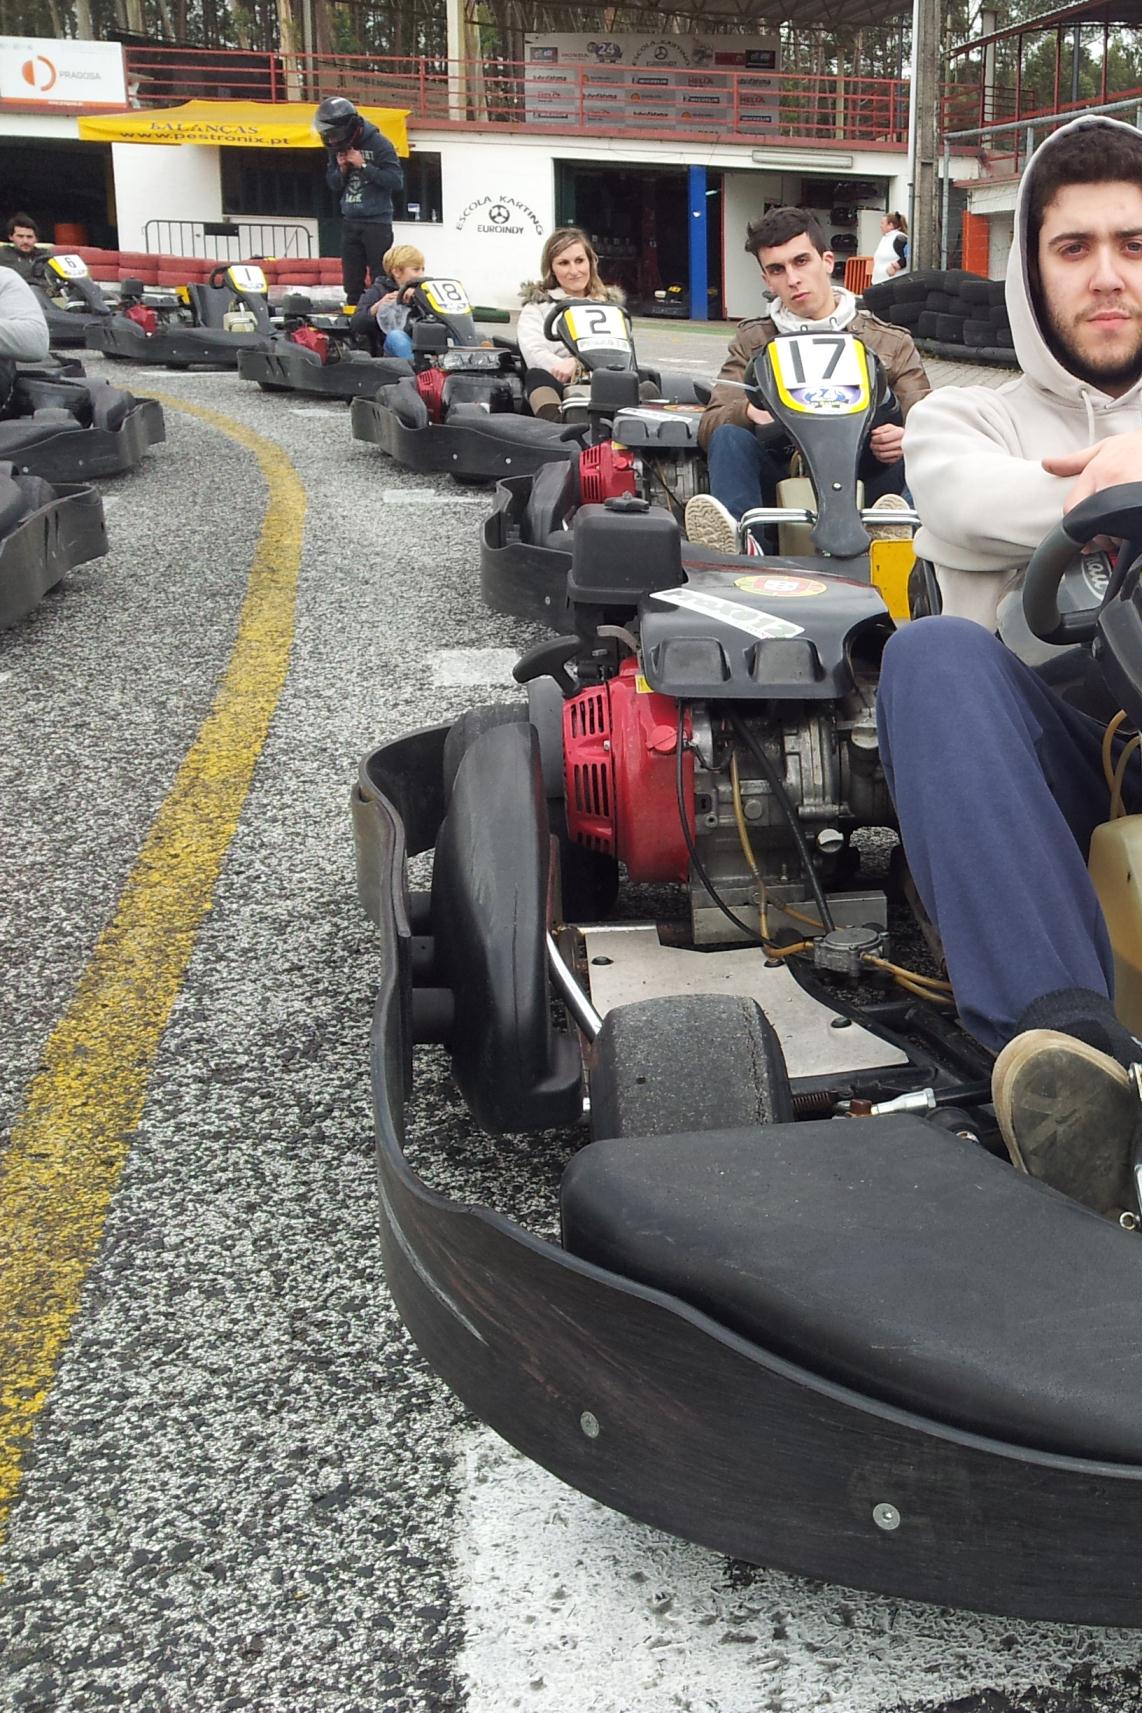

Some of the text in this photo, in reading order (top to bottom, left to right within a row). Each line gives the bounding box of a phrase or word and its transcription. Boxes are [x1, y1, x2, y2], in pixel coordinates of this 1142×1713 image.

[456, 194, 544, 236] ESCOLA KARTING
[477, 224, 524, 235] EUROINDY
[64, 256, 77, 269] 6
[244, 267, 251, 281] 1
[432, 283, 462, 302] 18
[585, 309, 612, 335] 2
[789, 338, 846, 384] 17
